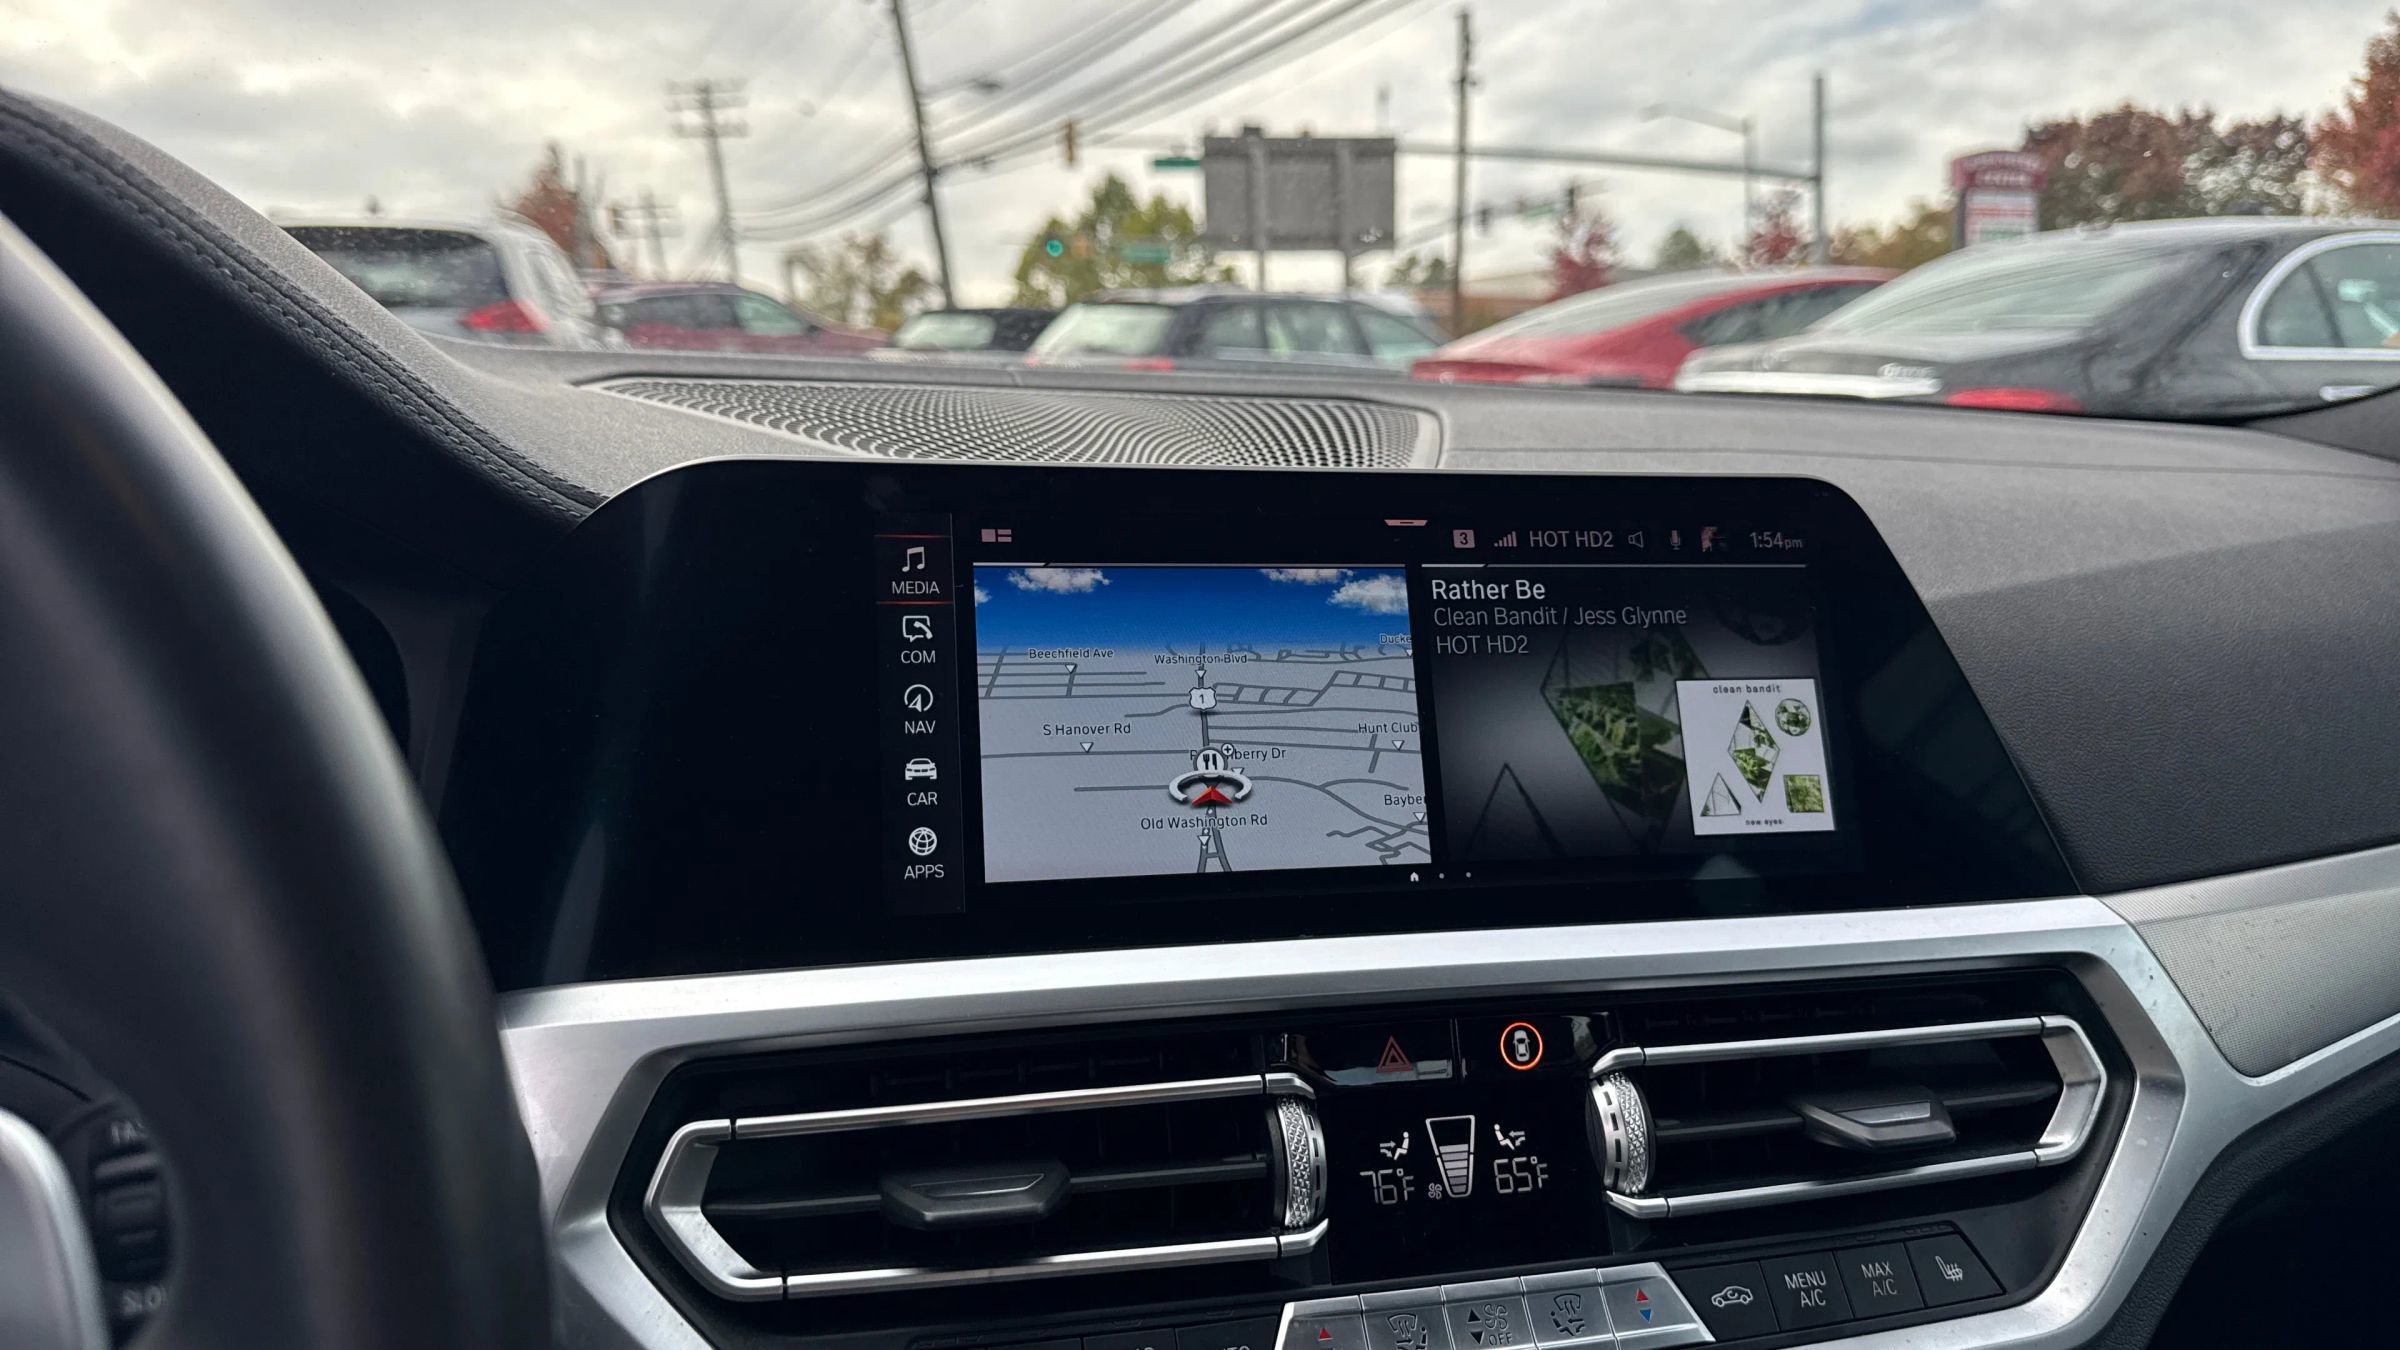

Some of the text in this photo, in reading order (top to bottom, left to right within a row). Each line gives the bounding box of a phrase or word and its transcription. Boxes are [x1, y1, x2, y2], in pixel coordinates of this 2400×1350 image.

[1459, 532, 1469, 545] 3
[1529, 530, 1615, 548] HOT HD2
[1750, 531, 1803, 550] 1:54pm
[892, 581, 941, 595] MEDIA
[1431, 579, 1546, 600] Rather Be
[1433, 606, 1688, 629] Clean Bandit / Jess Glynne
[1436, 634, 1529, 655] HOT HD2
[900, 650, 936, 664] COM
[1029, 648, 1114, 660] Beechfield Ave
[1154, 653, 1248, 666] Washington Blvd
[1712, 684, 1781, 695] clean bandit
[904, 720, 936, 735] NAV
[1043, 723, 1131, 736] S Hanover Rd
[1358, 721, 1418, 734] Hunt Club
[1271, 747, 1287, 759] Dr
[907, 791, 939, 806] CAR
[1140, 814, 1268, 830] Old Washington Rd
[904, 864, 945, 880] APPS
[1861, 1261, 1894, 1279] MAX
[1784, 1270, 1827, 1289] MENU
[1872, 1278, 1897, 1297] A/C
[1800, 1288, 1827, 1308] A/C
[1488, 1332, 1514, 1347] OFF
